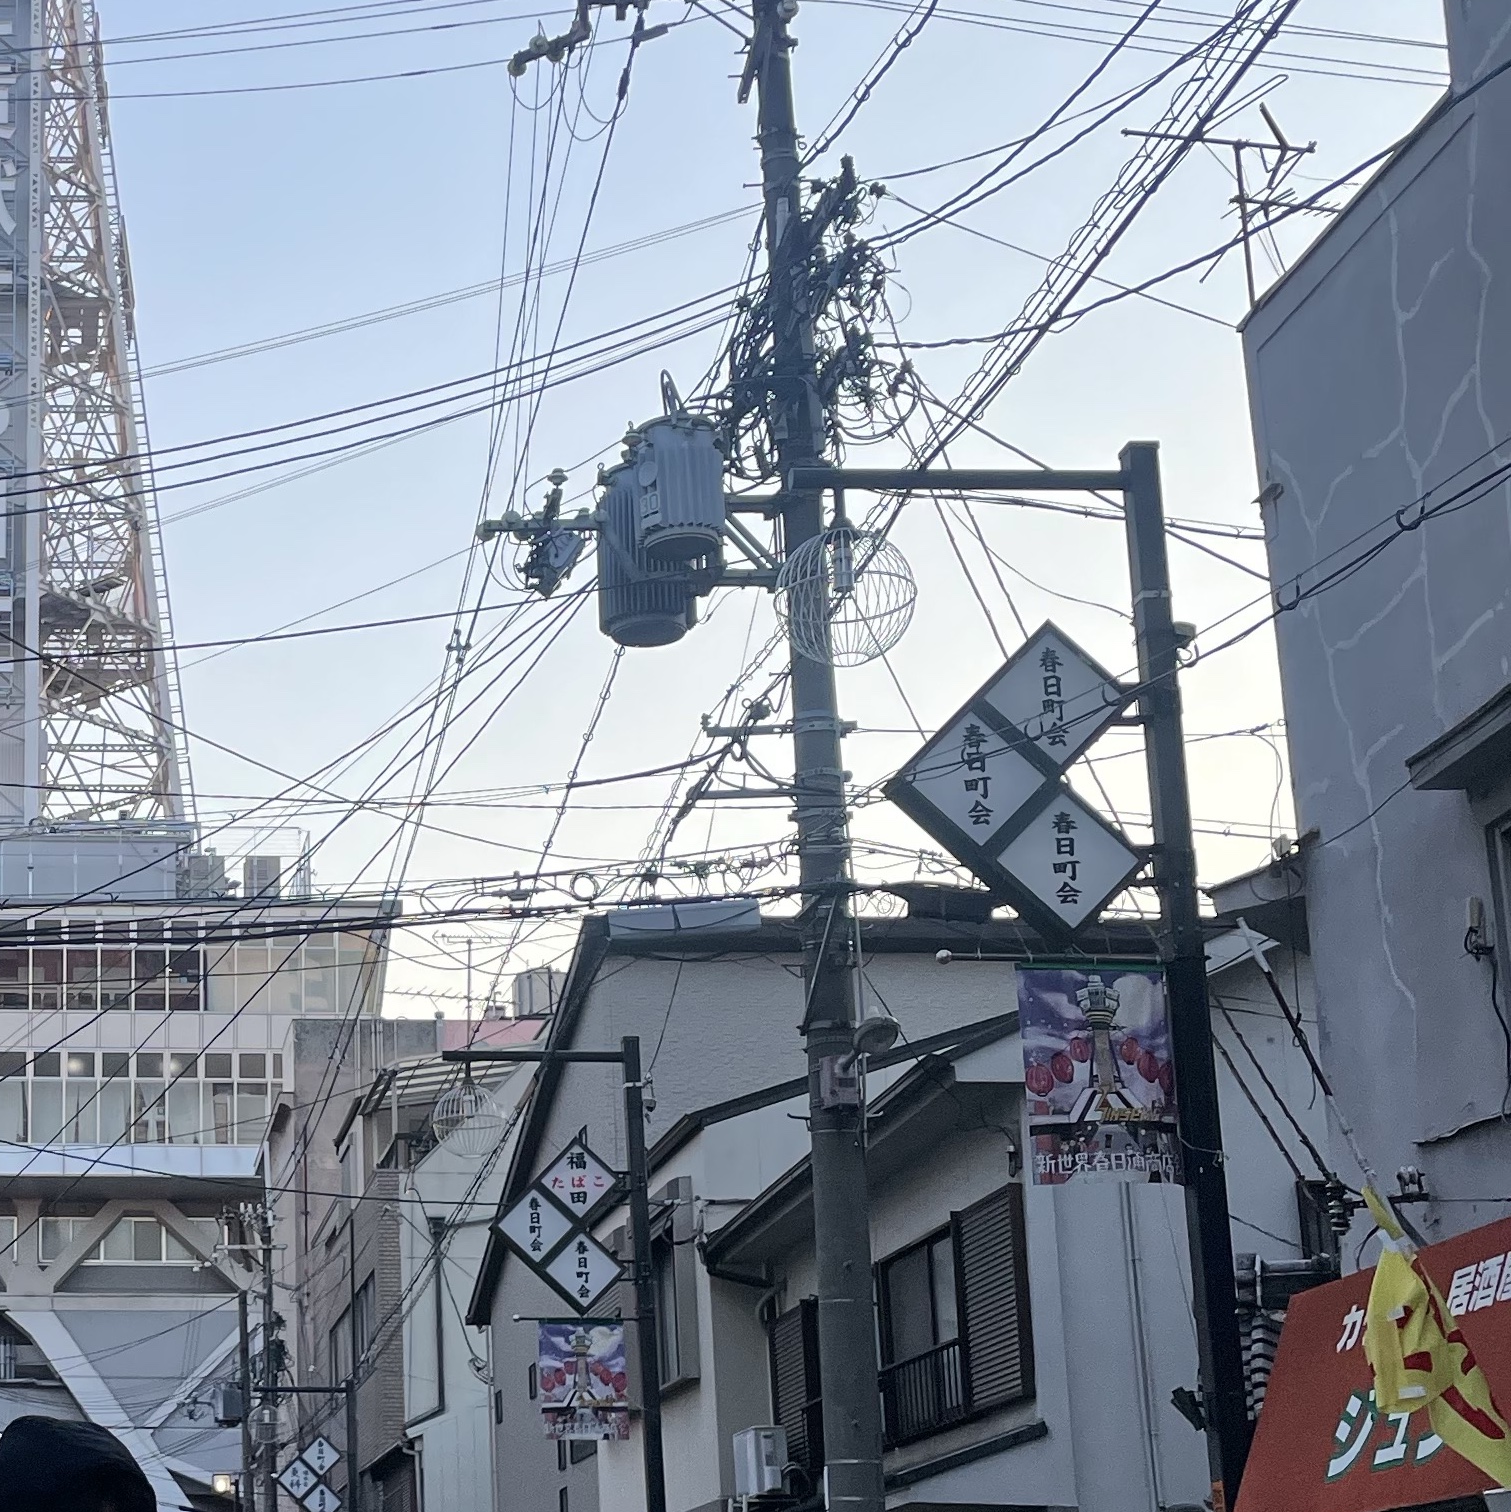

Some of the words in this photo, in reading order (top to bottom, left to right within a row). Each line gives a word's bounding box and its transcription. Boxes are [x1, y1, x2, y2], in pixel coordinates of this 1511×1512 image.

[1039, 647, 1067, 747] 春日町会
[962, 723, 994, 826] 春日町会
[1051, 811, 1083, 905] 春日町会
[551, 1174, 605, 1189] たばこ
[1035, 1150, 1181, 1179] 新世界春日通商店
[528, 1196, 544, 1252] 春日町会
[575, 1240, 591, 1299] 春日町会
